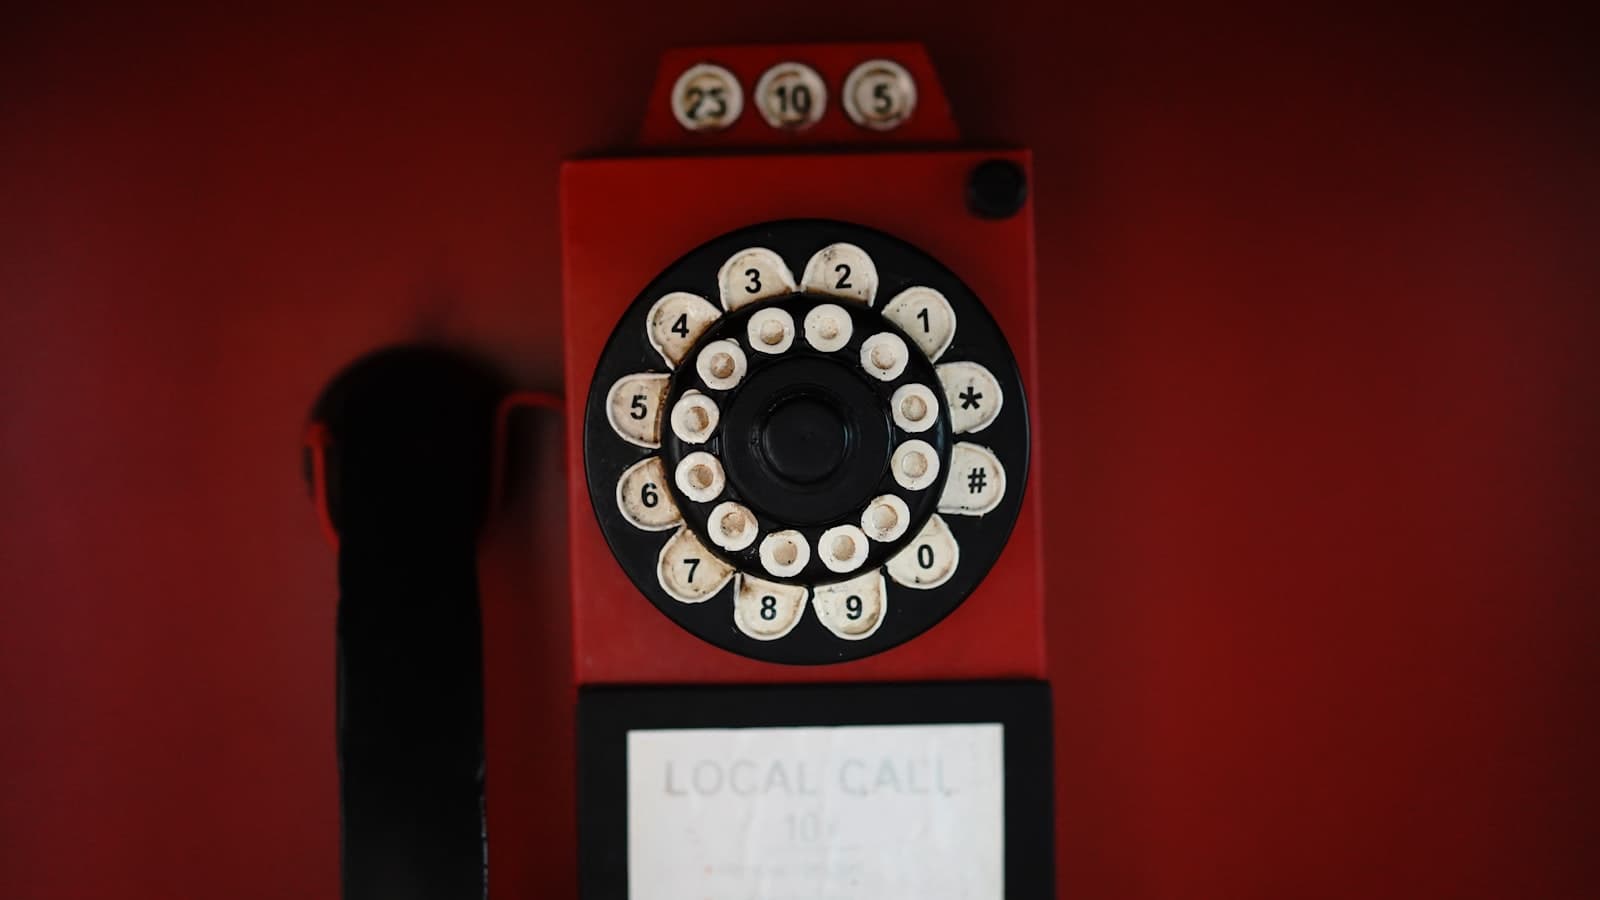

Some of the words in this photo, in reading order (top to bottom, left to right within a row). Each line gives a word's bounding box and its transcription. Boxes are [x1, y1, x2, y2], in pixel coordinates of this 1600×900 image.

[685, 87, 728, 120] 25
[775, 84, 812, 116] 10
[873, 82, 893, 113] 5
[744, 268, 762, 294] 3
[834, 263, 853, 290] 2
[671, 313, 690, 339] 4
[916, 307, 930, 333] 1
[630, 395, 648, 421] 5
[641, 483, 659, 509] 6
[917, 544, 934, 570] 0
[683, 558, 701, 584] 7
[760, 595, 777, 621] 8
[845, 595, 863, 621] 9
[664, 759, 820, 798] LOCAL
[838, 757, 962, 798] CALL
